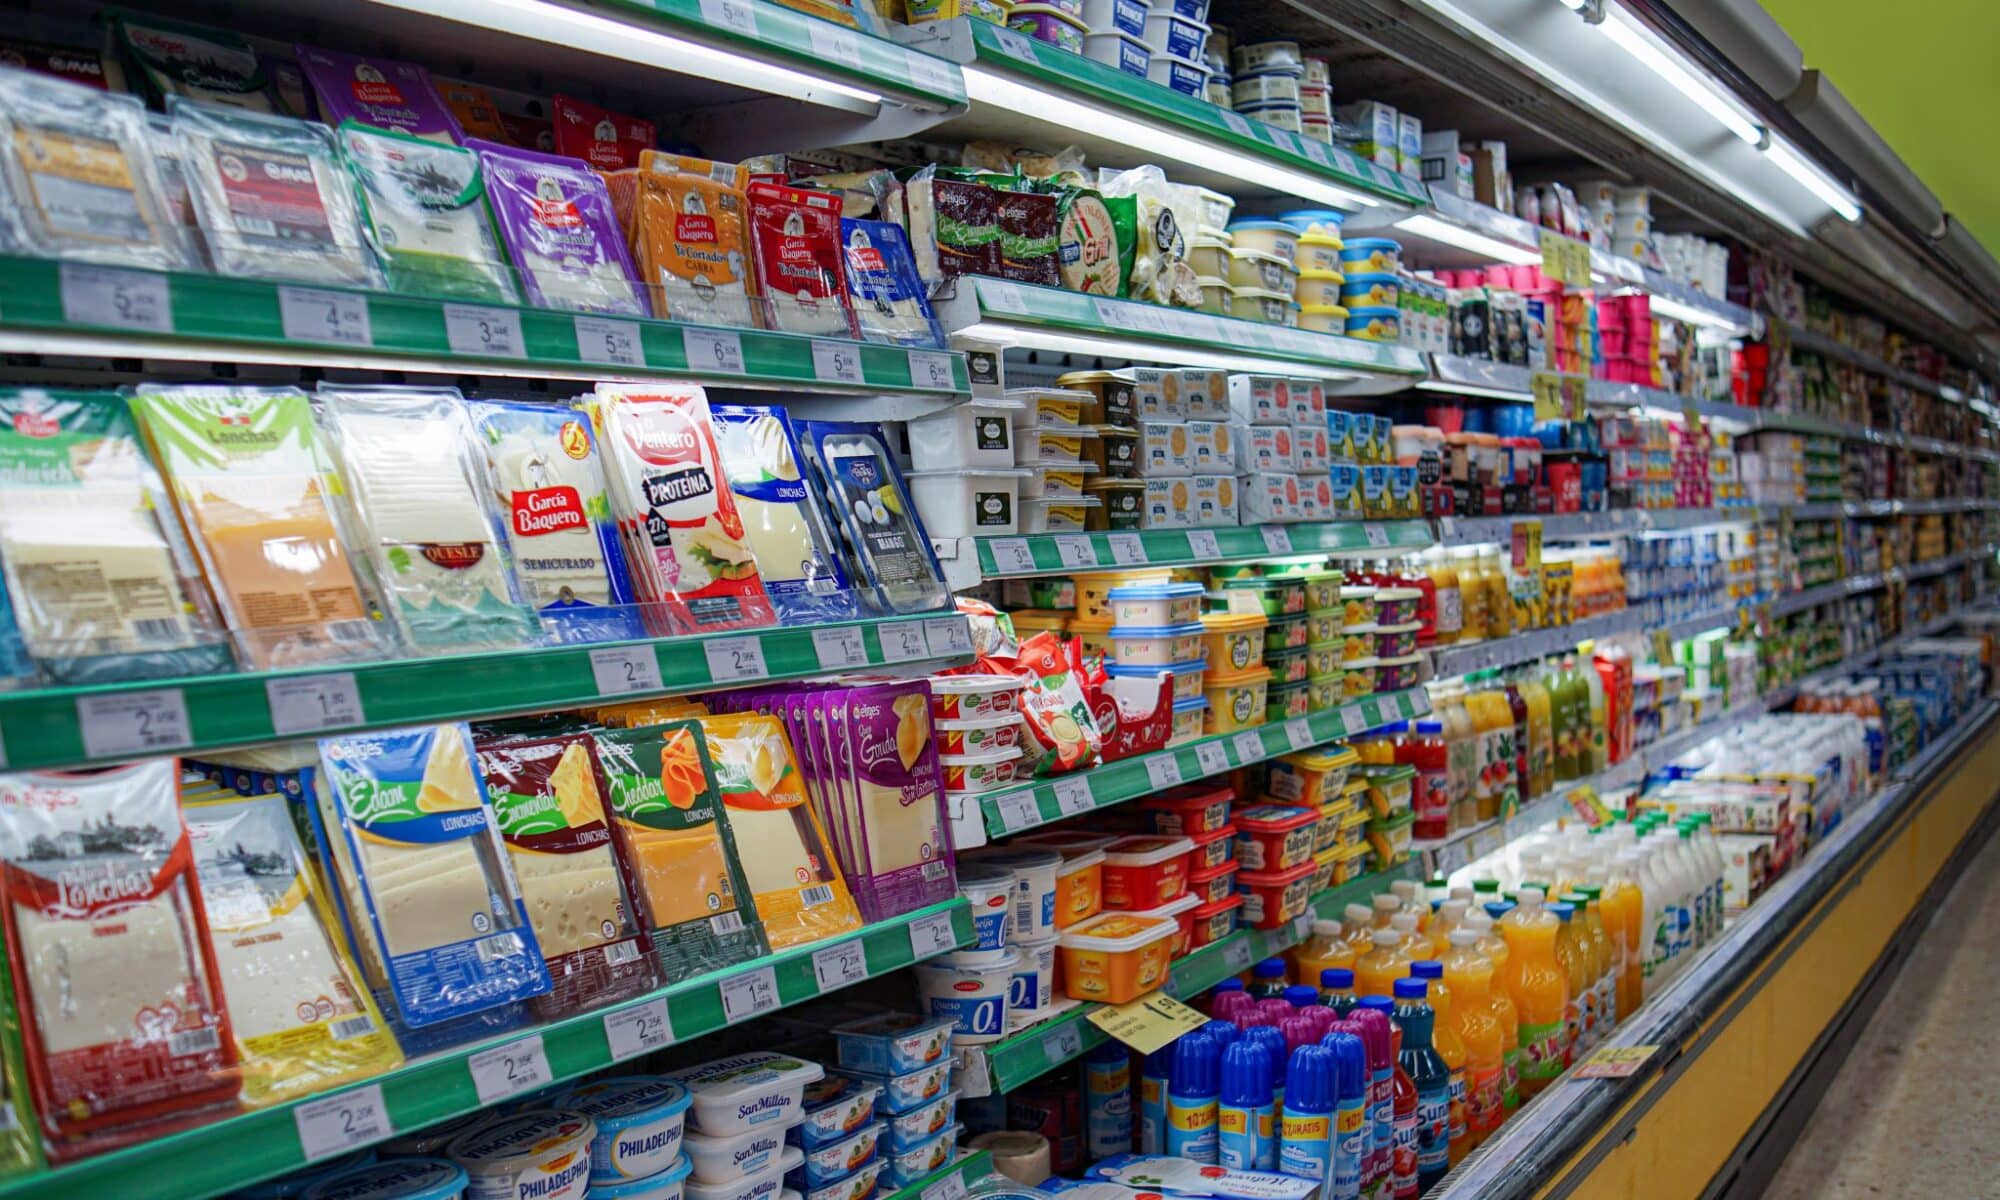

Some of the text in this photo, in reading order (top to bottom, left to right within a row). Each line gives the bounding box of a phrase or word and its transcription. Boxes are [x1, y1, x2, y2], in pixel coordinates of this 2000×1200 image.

[677, 225, 714, 241] Baquero
[480, 321, 491, 343] 3
[606, 335, 616, 354] 5
[714, 342, 725, 361] 6
[834, 351, 843, 372] 5
[209, 428, 278, 444] Lonchas
[650, 470, 710, 504] PROTEÍNA
[776, 486, 806, 499] LONCHAS
[527, 493, 568, 512] García
[517, 509, 580, 532] Baquero
[523, 557, 595, 571] SEMICURADO
[901, 632, 910, 649] 2
[731, 651, 744, 669] 2
[623, 662, 637, 681] 2
[860, 704, 881, 718] eliges
[135, 711, 152, 735] 2
[860, 727, 897, 765] Gouda
[349, 779, 407, 820] Edam
[609, 772, 665, 812] Cheddar
[771, 791, 804, 804] LONCHAS
[1070, 790, 1079, 805] 2
[494, 777, 561, 830] Emmental
[441, 812, 486, 832] LONCHAS
[683, 807, 714, 823] LONCHAS
[576, 829, 610, 846] LONCHAS
[932, 926, 941, 943] 2
[841, 956, 849, 974] 2
[637, 1019, 649, 1040] 2
[504, 1058, 518, 1080] 2
[339, 1109, 356, 1134] 2
[619, 1123, 682, 1160] PHILADELPHIA
[519, 1157, 589, 1200] PHILADELPHIA
